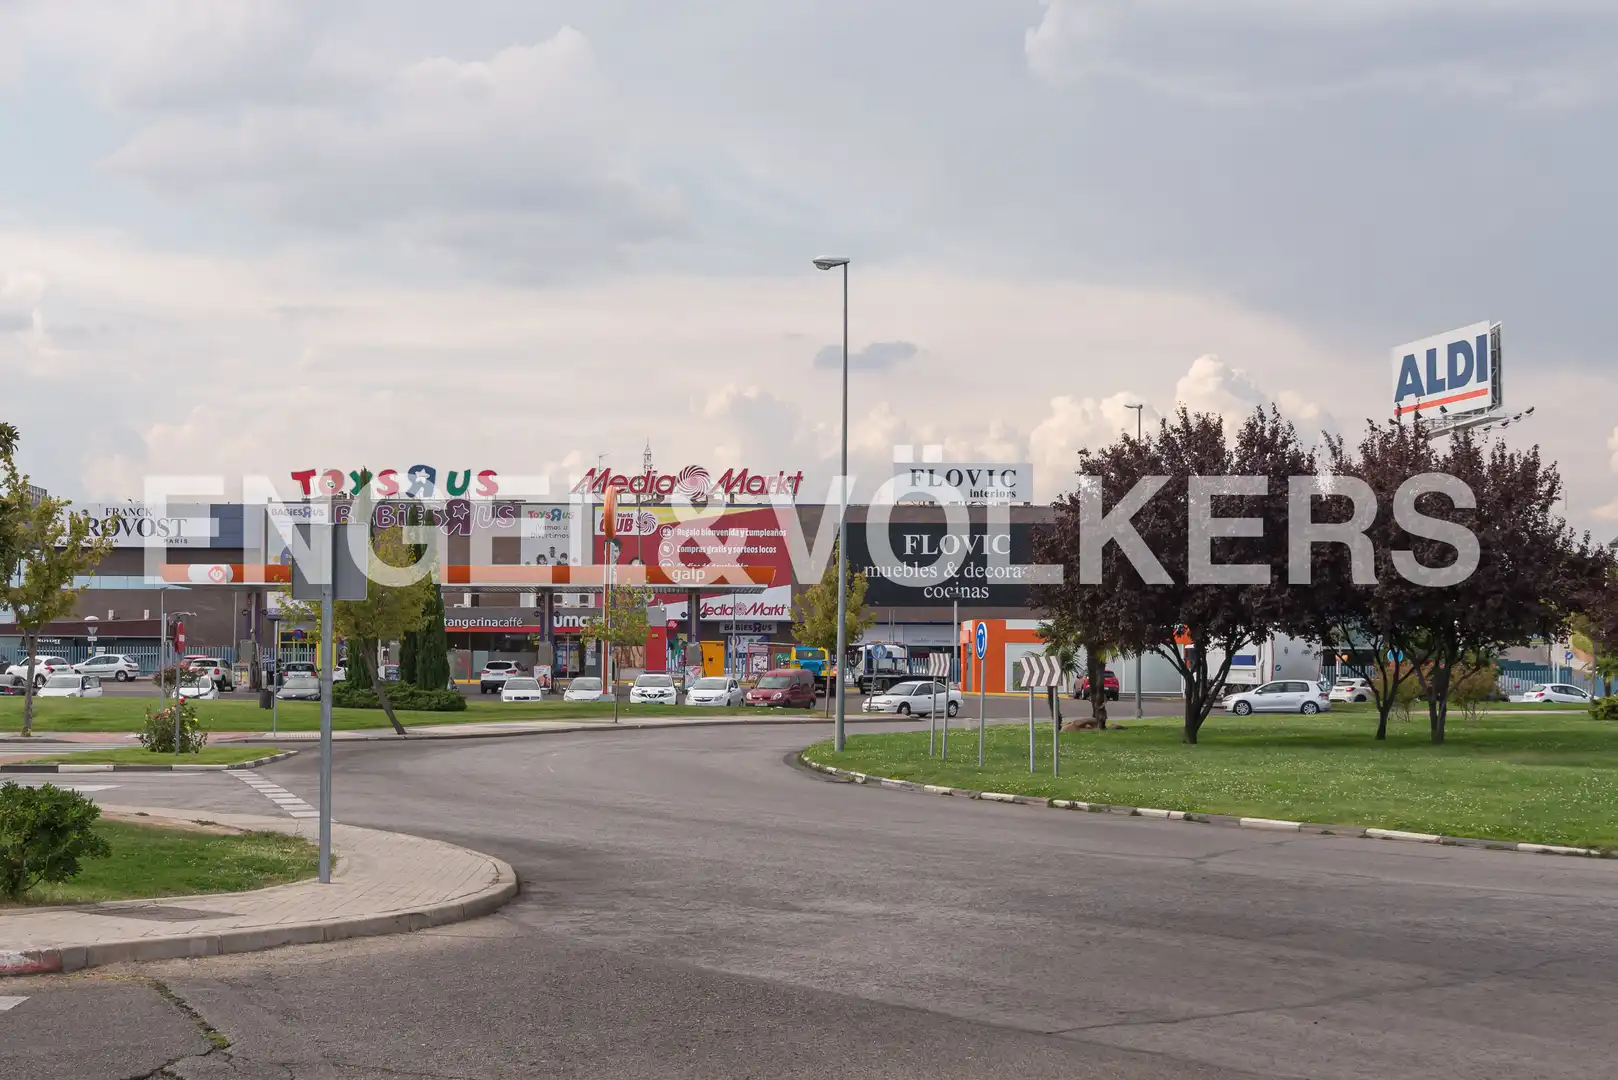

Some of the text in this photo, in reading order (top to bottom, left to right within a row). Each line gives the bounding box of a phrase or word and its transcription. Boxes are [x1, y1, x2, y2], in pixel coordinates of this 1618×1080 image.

[1394, 334, 1488, 402] ALDI
[570, 467, 804, 495] Media Markt
[909, 468, 1017, 488] FLOVIC
[969, 488, 1017, 499] interiors
[105, 507, 153, 517] FRANCK
[599, 518, 634, 533] CUB
[677, 528, 700, 537] Regalo
[701, 528, 739, 536] bienvenida
[746, 528, 787, 538] cumpleaños
[677, 545, 704, 554] Compras
[706, 545, 727, 555] gratis
[759, 545, 777, 553] locos
[903, 534, 1011, 555] FLOVIC
[671, 567, 706, 583] galp
[865, 562, 938, 578] muebles
[943, 562, 960, 578] &
[923, 582, 990, 599] cocinas
[744, 603, 786, 616] Markt
